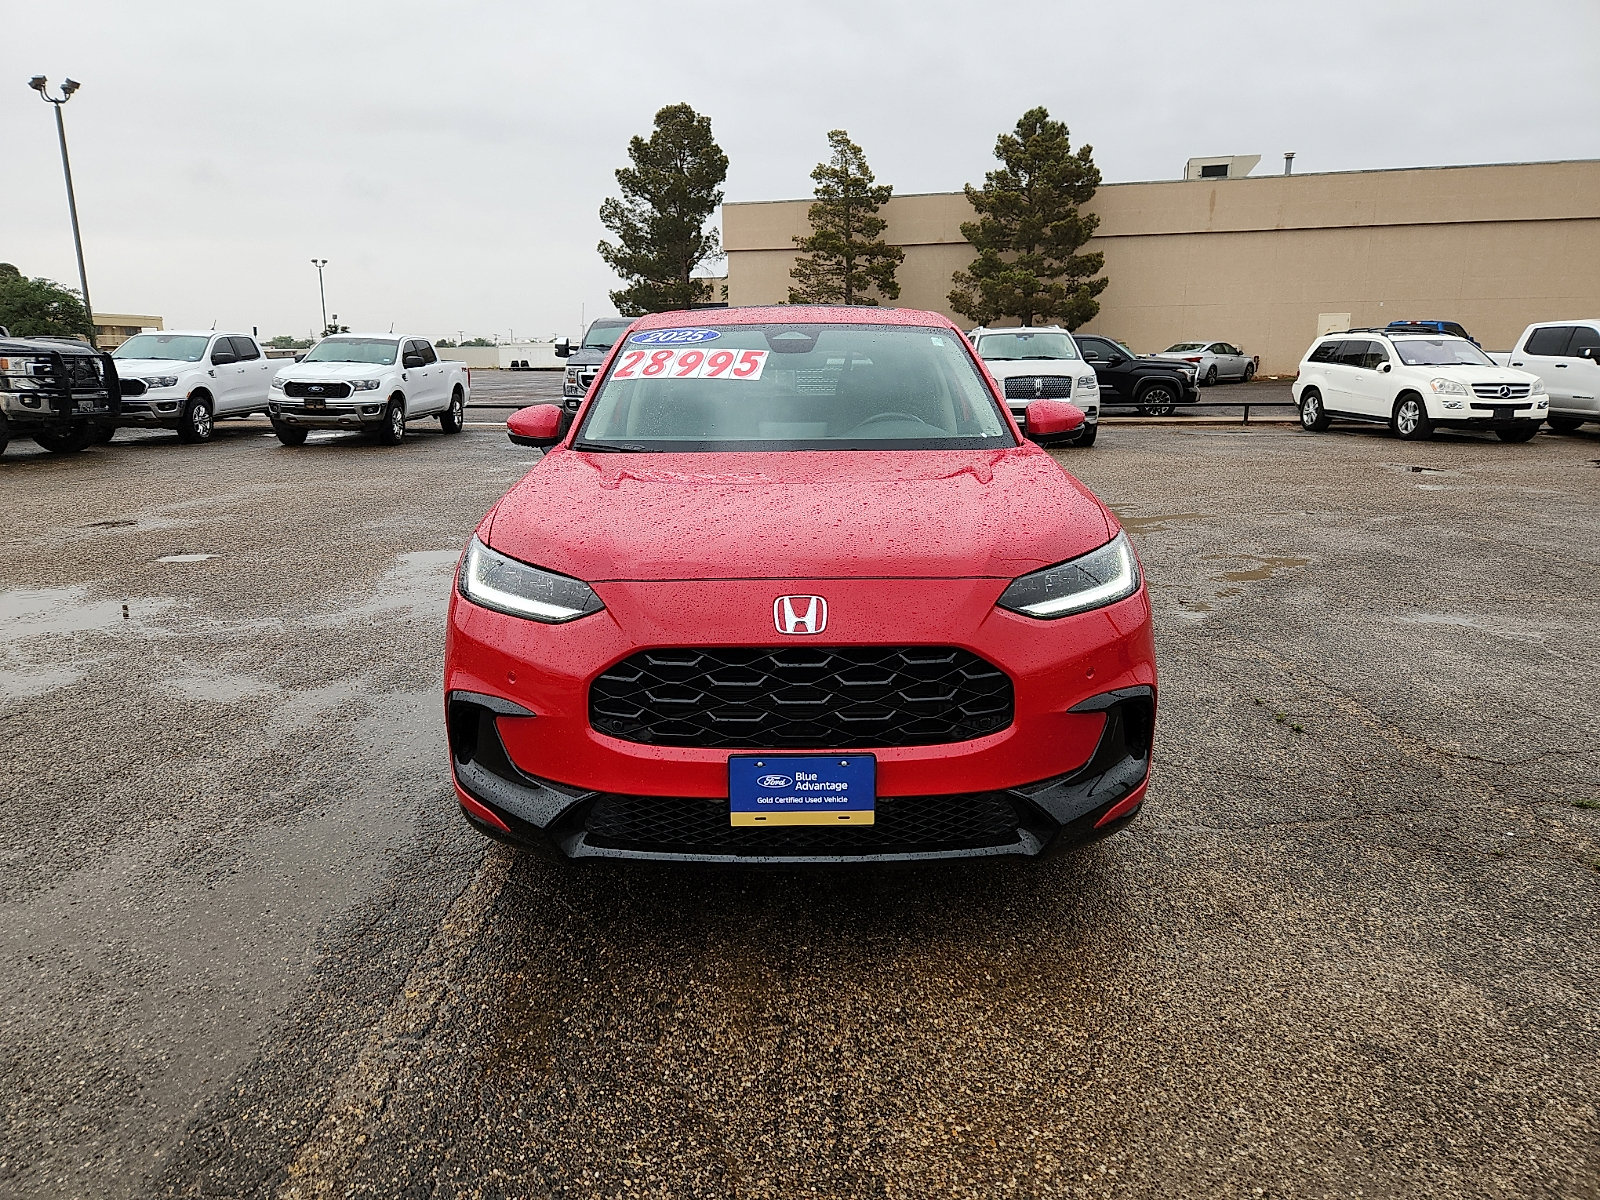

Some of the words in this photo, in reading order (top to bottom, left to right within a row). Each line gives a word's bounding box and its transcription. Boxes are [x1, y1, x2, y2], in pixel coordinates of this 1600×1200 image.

[642, 329, 705, 343] 2025
[613, 350, 766, 378] 28995
[795, 772, 818, 781] Blue
[795, 781, 849, 792] Advantage
[757, 796, 774, 804] Gold
[774, 796, 803, 804] Certified
[804, 796, 822, 804] Used
